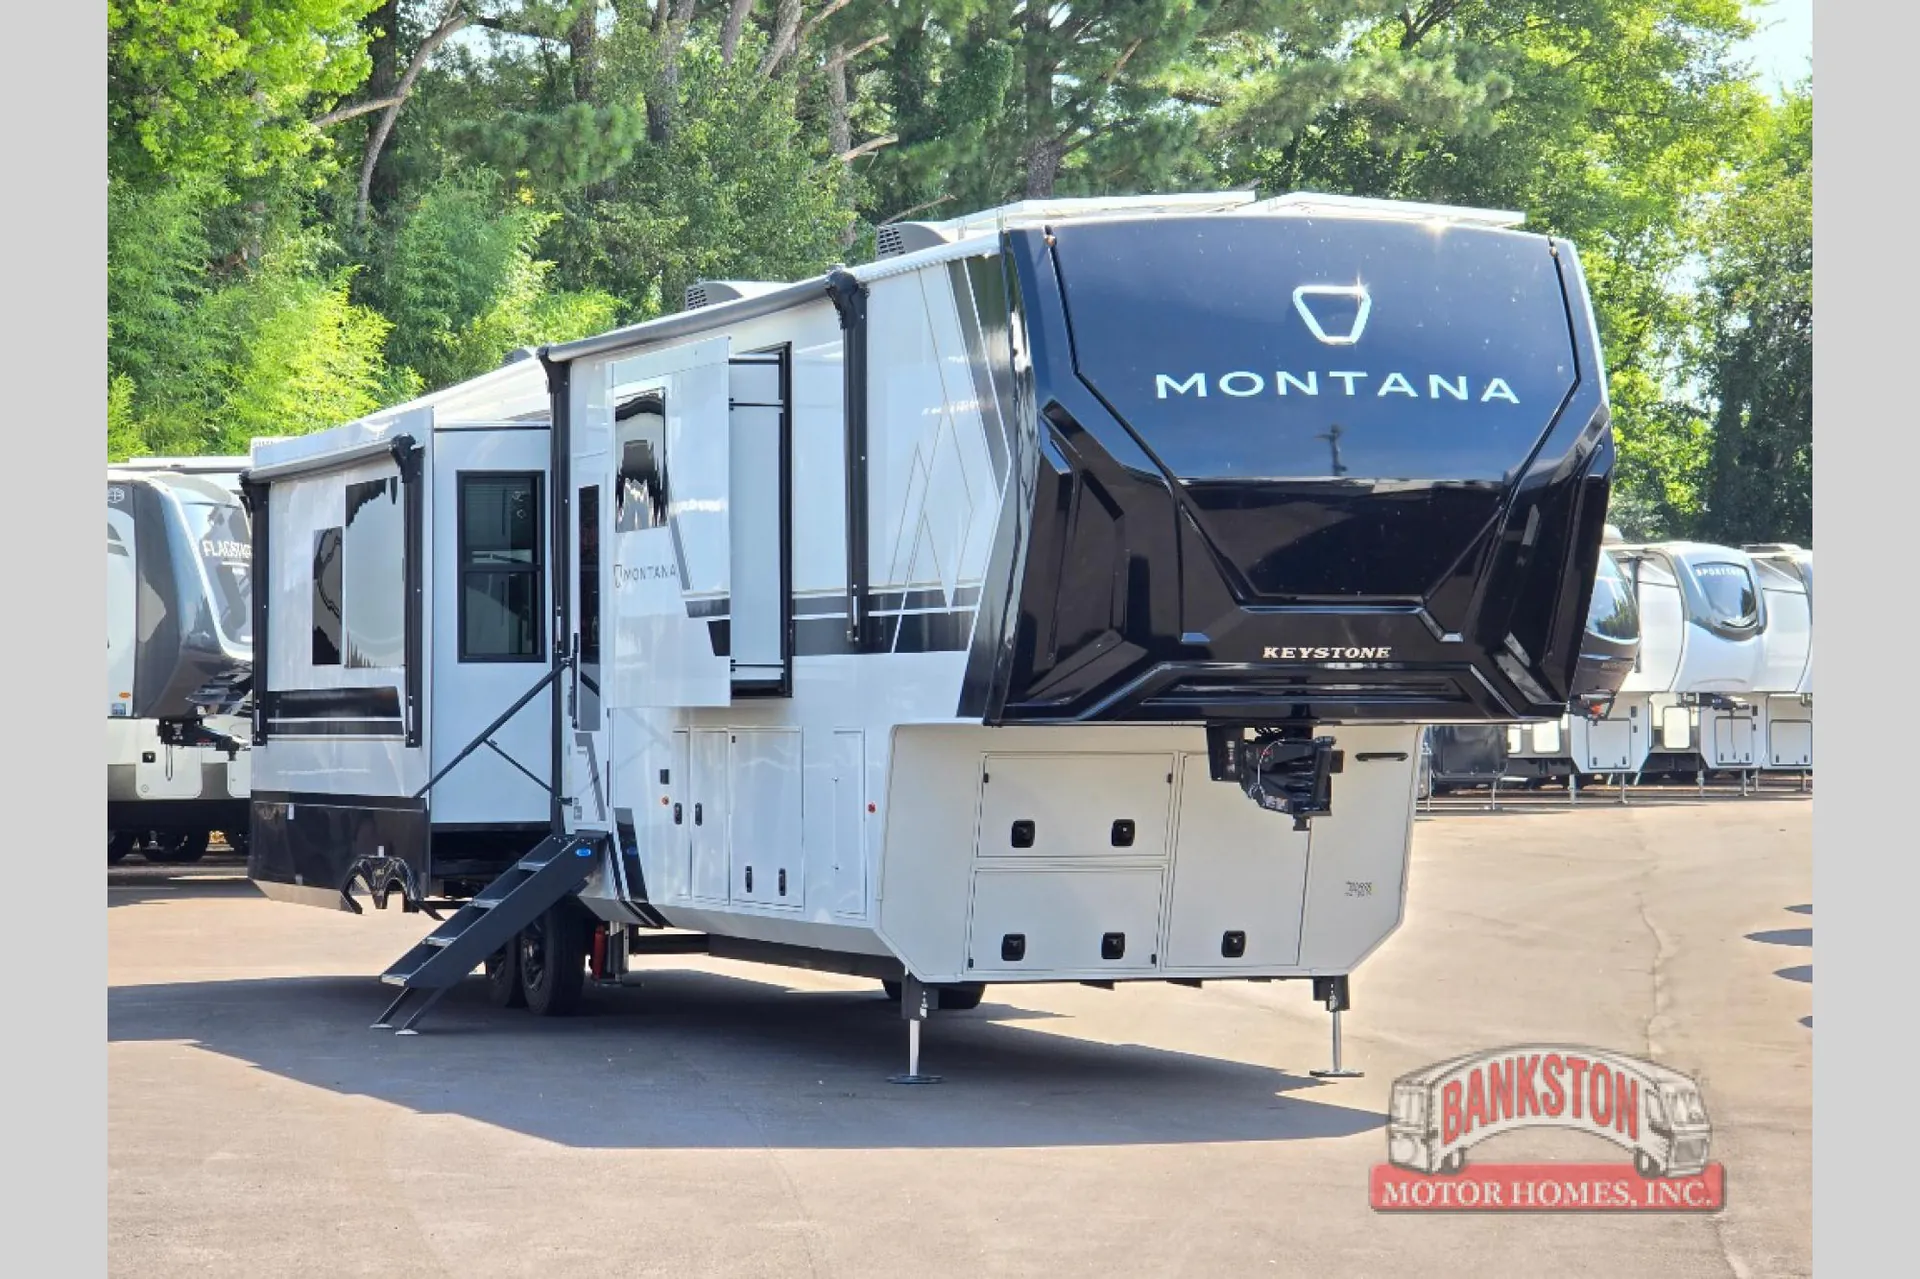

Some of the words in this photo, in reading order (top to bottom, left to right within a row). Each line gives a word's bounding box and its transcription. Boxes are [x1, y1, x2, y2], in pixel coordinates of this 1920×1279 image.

[1155, 370, 1521, 404] MONTANA
[623, 564, 676, 581] MONTANA
[1262, 646, 1392, 659] KEYSTONE
